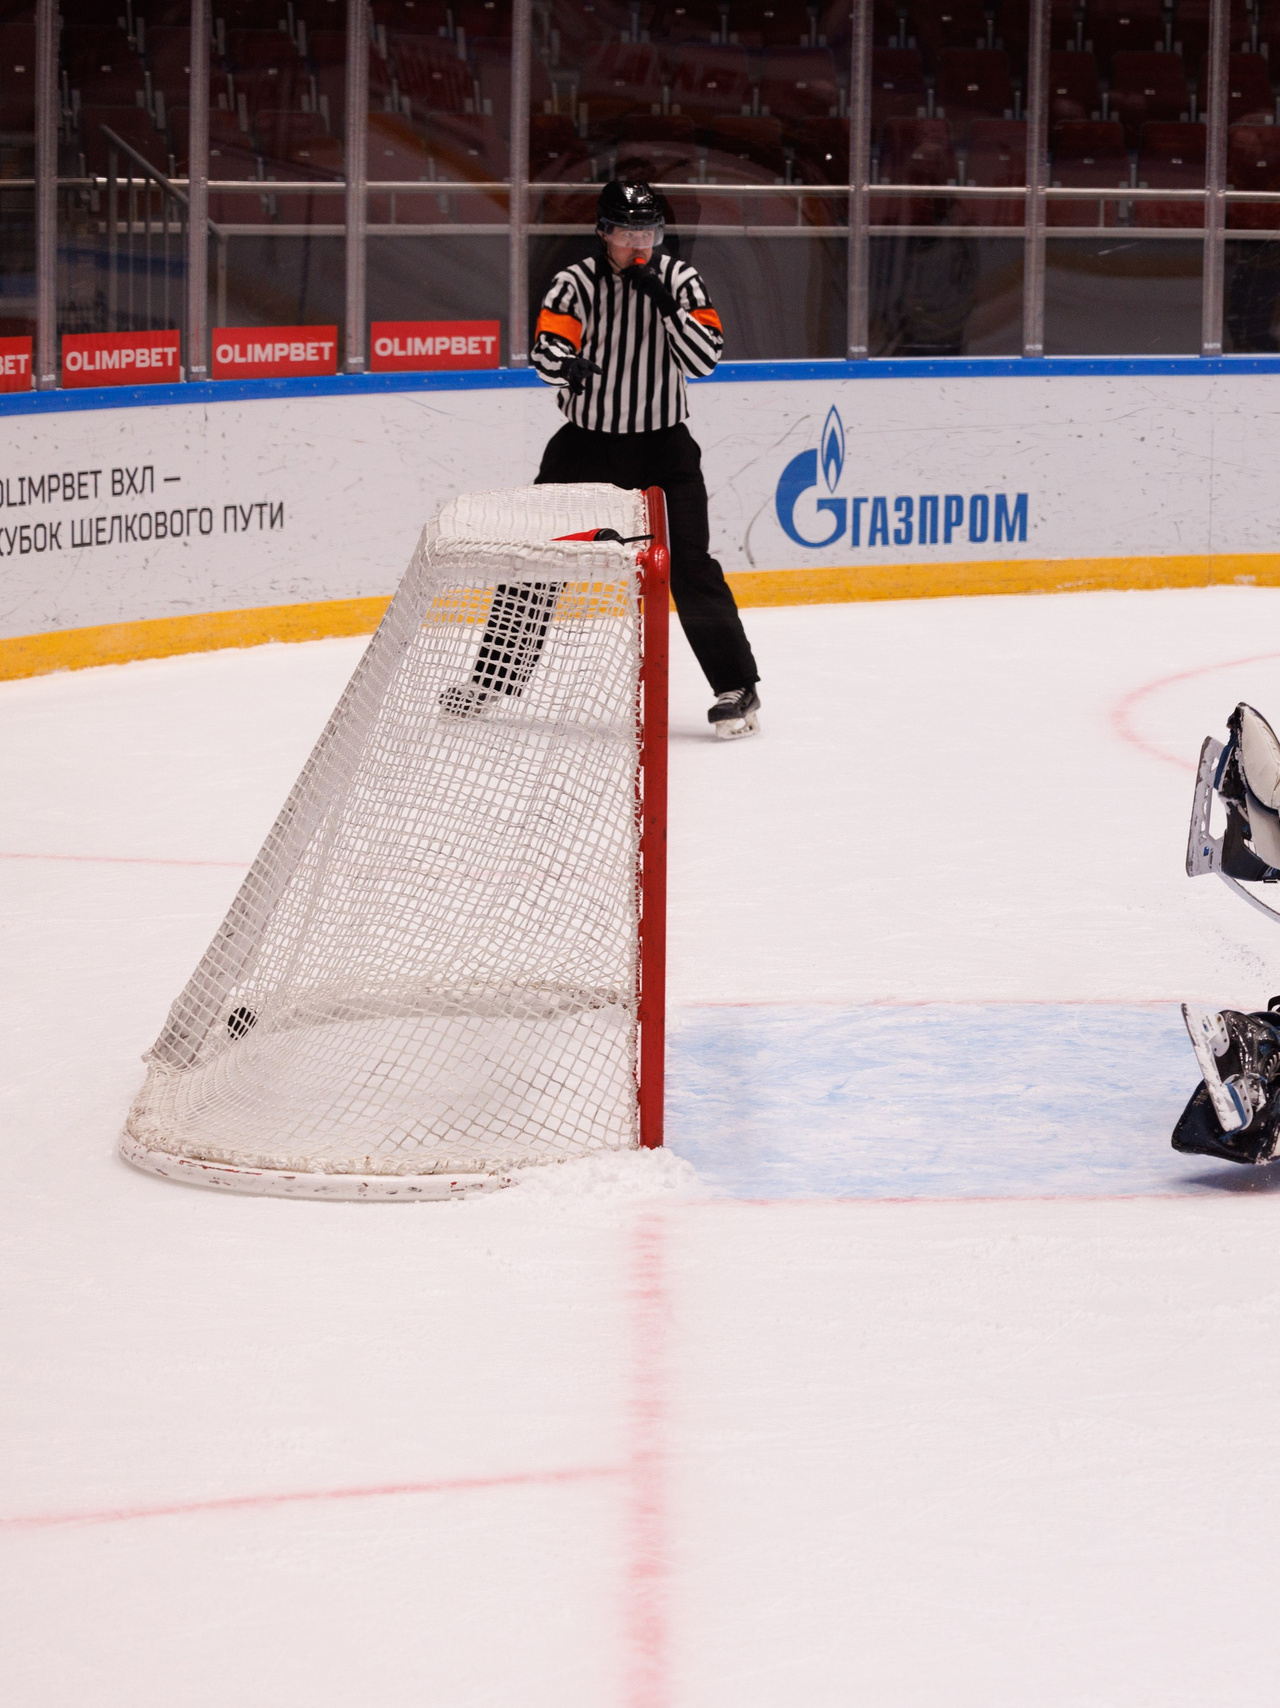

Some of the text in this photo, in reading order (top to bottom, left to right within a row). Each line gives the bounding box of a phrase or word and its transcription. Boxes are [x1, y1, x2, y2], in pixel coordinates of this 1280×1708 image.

[65, 347, 178, 372] OLIMPBET
[216, 341, 335, 365] OLIMPBET
[375, 336, 497, 358] OLIMPBET
[0, 470, 102, 508] LIMPBET
[112, 465, 154, 497] ВХЛ
[0, 501, 284, 557] УБОК ШЕЛКОВОГО ПУТИ
[851, 493, 1028, 548] ГАЗПРОМ
